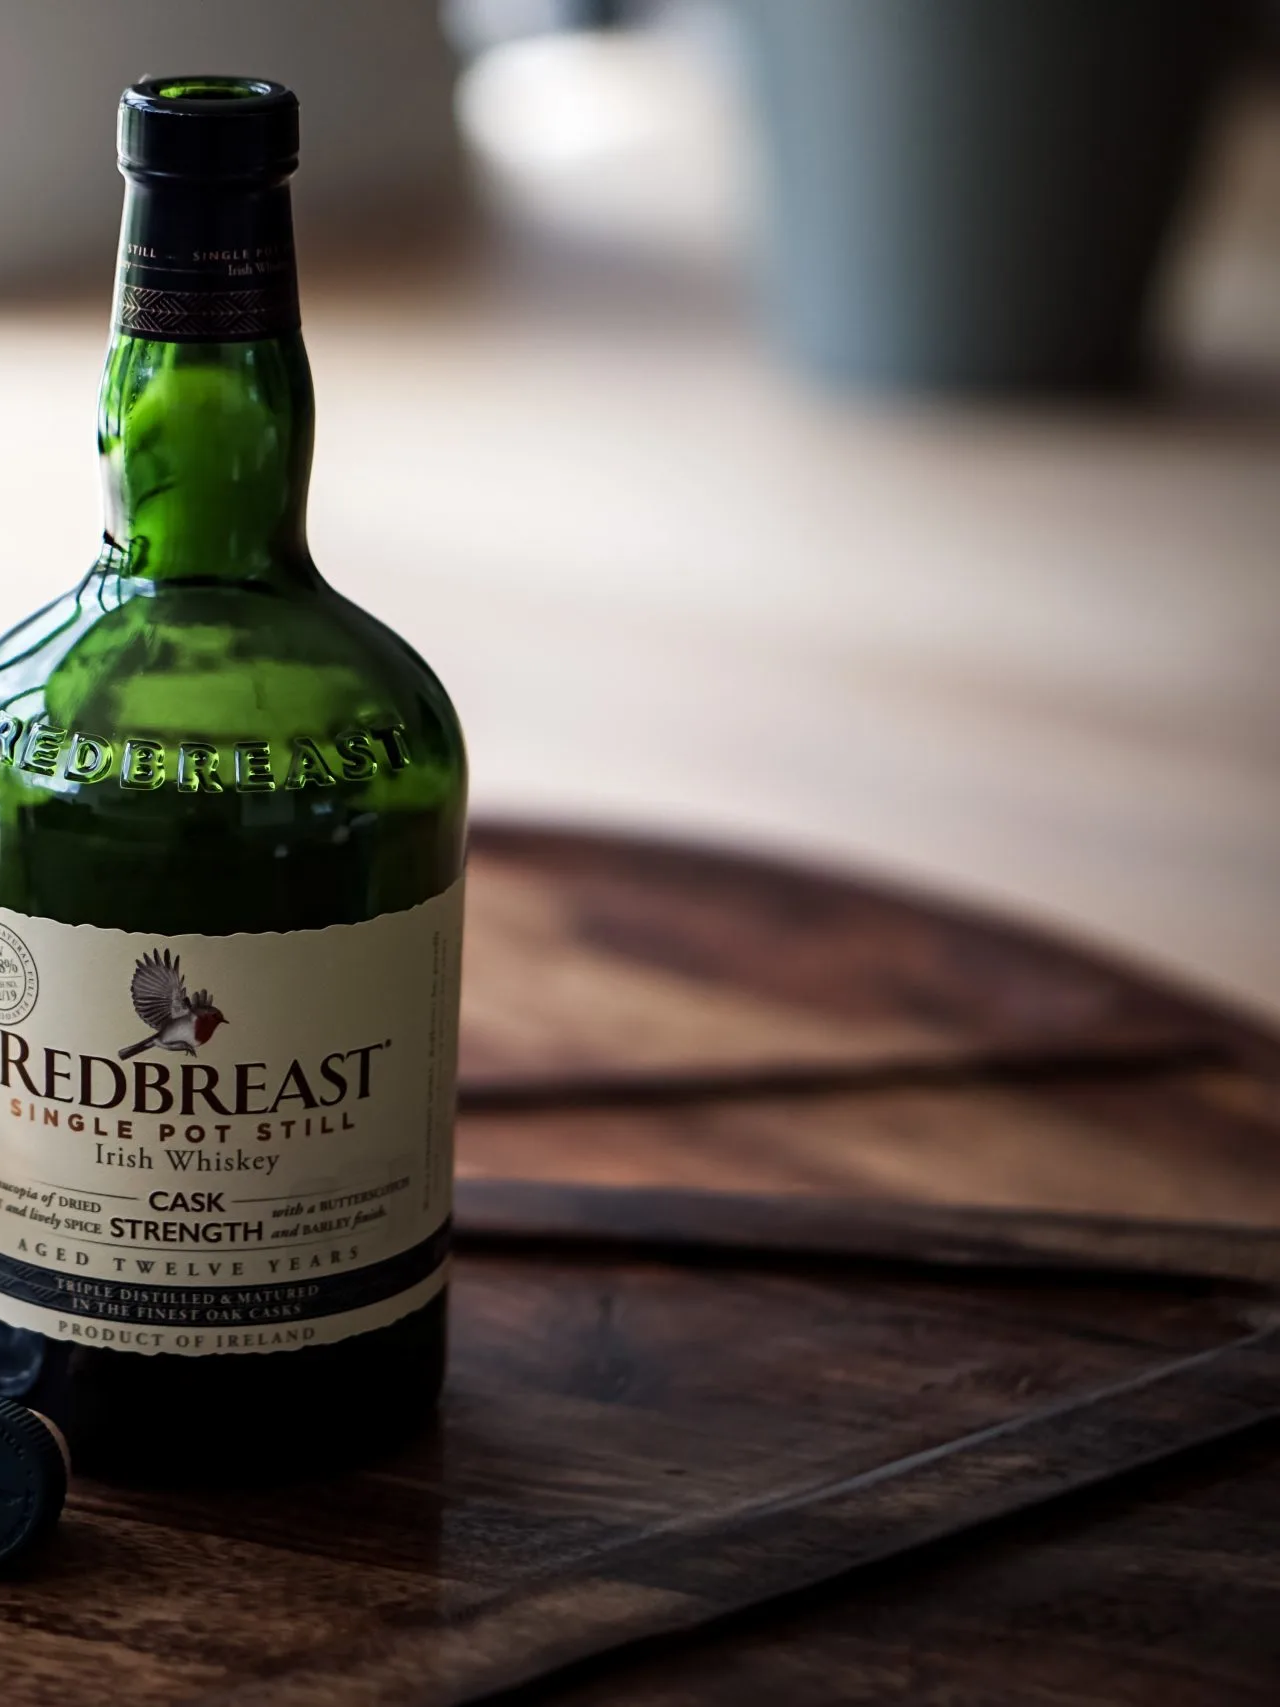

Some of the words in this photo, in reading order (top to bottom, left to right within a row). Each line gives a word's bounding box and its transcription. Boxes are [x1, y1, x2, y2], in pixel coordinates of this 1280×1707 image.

[128, 243, 157, 258] STILL
[192, 249, 249, 261] SINGLE
[228, 263, 253, 276] Irish
[0, 1029, 384, 1117] REDBREAST
[10, 1098, 133, 1140] SINGLE
[160, 1123, 231, 1144] POT
[257, 1112, 356, 1142] STILL
[95, 1142, 154, 1170] Irish
[164, 1149, 280, 1175] Whiskey
[41, 1192, 56, 1207] of
[58, 1196, 102, 1213] DRIED
[148, 1191, 226, 1212] CASK
[272, 1202, 304, 1218] with
[307, 1204, 316, 1214] a
[5, 1204, 28, 1217] and
[29, 1207, 61, 1229] lively
[64, 1218, 102, 1234] SPICE
[110, 1217, 263, 1243] STRENGTH
[271, 1222, 300, 1239] and
[302, 1216, 351, 1236] BARLEY
[17, 1238, 90, 1266] AGED
[113, 1258, 244, 1276] TWELVE
[268, 1245, 358, 1273] YEARS
[55, 1277, 113, 1298] TRIPLE
[120, 1288, 215, 1304] DISTILLED
[221, 1294, 232, 1304] &
[237, 1285, 320, 1303] MATURED
[72, 1298, 90, 1310] IN
[97, 1302, 130, 1317] THE
[137, 1306, 201, 1321] FINEST
[206, 1309, 243, 1321] OAK
[249, 1303, 302, 1319] CASKS
[58, 1320, 164, 1347] PRODUCT
[176, 1335, 205, 1348] OF
[216, 1327, 316, 1348] IRELAND
